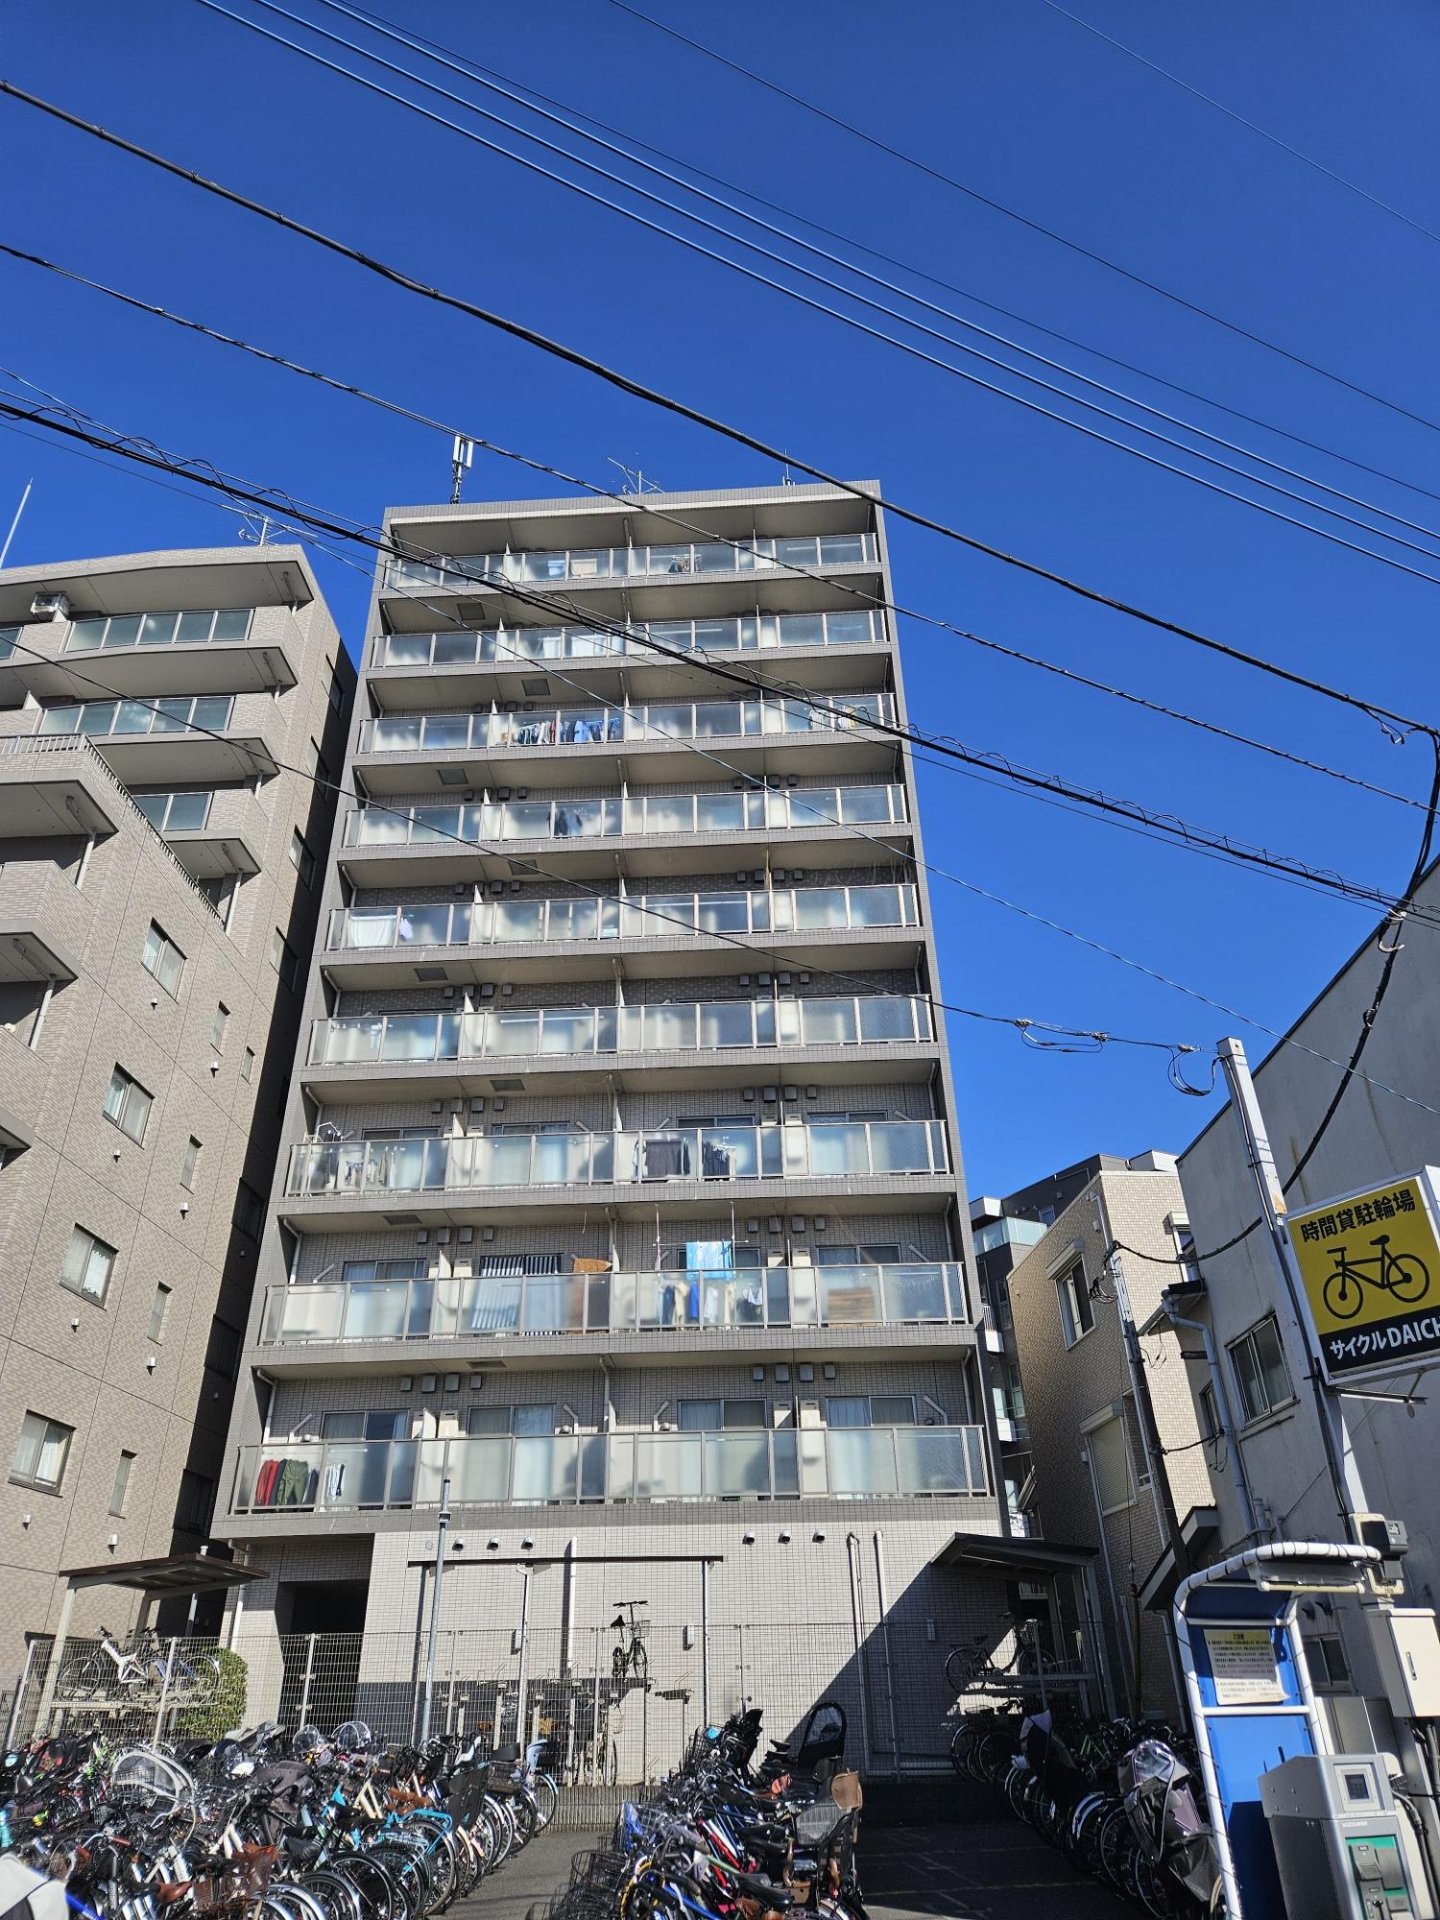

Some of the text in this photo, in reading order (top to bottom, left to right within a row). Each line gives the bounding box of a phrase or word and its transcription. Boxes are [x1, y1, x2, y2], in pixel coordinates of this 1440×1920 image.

[1301, 1189, 1416, 1243] 時間貸駐輪場
